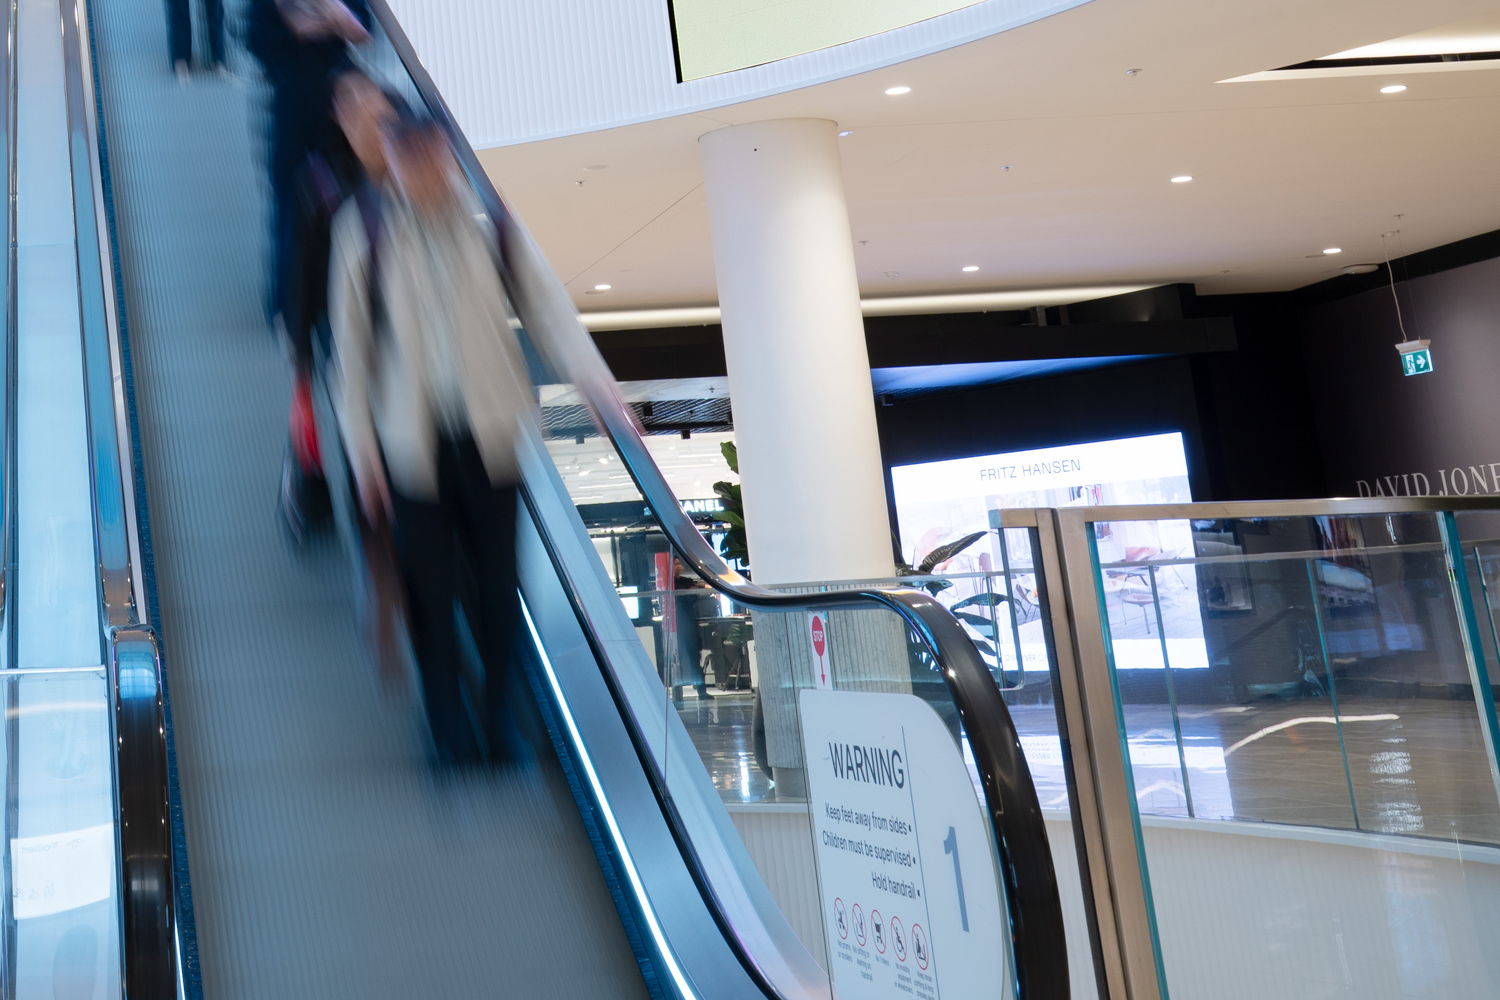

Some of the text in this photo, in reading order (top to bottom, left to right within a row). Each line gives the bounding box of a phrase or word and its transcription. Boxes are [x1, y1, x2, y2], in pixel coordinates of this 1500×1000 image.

[980, 459, 1081, 481] FRITZ HANSEN
[1356, 463, 1500, 498] DAVID JONE
[680, 499, 725, 512] ANEL
[813, 630, 823, 642] STOP
[829, 742, 904, 789] WARNING
[825, 802, 907, 835] Keep feet away from sides
[822, 830, 912, 868] Children must be supervised
[871, 871, 916, 900] Hold handrail
[943, 825, 970, 933] 1
